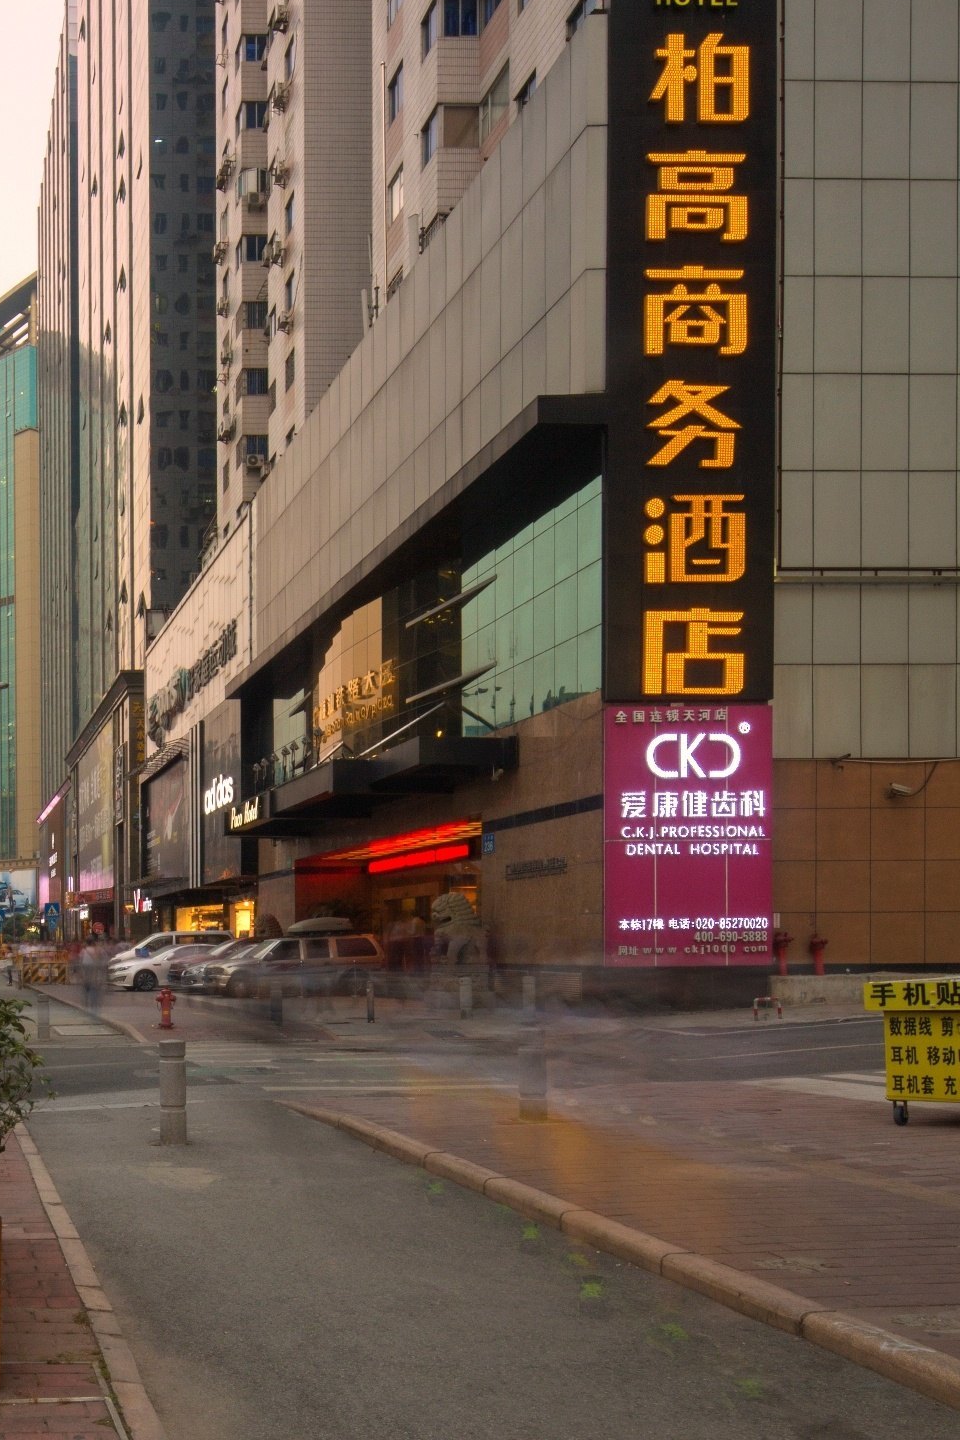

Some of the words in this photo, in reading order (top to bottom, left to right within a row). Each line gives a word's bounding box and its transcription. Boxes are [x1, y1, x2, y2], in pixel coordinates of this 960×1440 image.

[644, 33, 749, 695] 柏高商务酒店
[615, 709, 727, 723] 全国连锁天河店
[230, 807, 243, 830] Paco
[243, 796, 259, 824] Hotel
[620, 790, 766, 818] 爱康健齿科
[626, 843, 680, 856] DENTAL
[690, 842, 759, 855] HOSPITAL
[694, 931, 768, 943] 400-690-5888
[889, 1016, 933, 1037] 数据线
[941, 1016, 960, 1037] 剪
[890, 1045, 919, 1066] 耳机
[926, 1045, 960, 1066] 移动
[891, 1074, 935, 1095] 耳机套
[943, 1075, 958, 1096] 充
